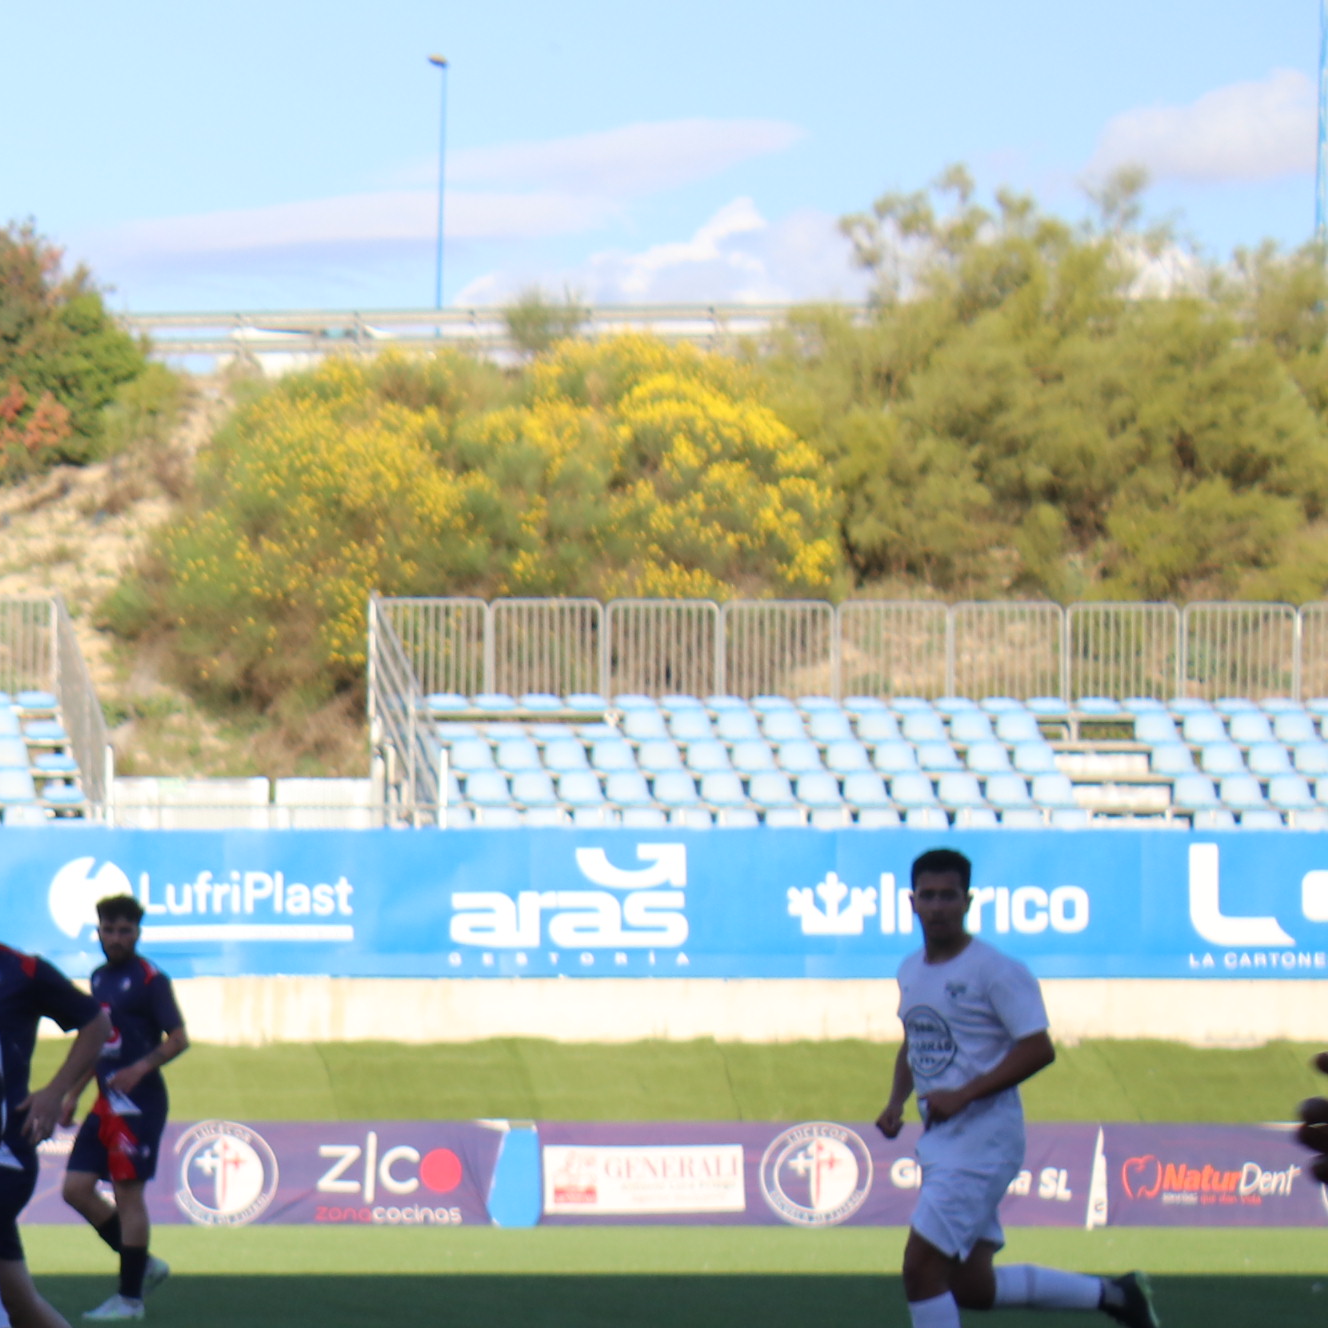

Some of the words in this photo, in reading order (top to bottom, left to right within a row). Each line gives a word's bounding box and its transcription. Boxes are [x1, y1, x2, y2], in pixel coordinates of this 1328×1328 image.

[140, 870, 354, 916] LufriPlast
[449, 889, 689, 949] aras
[1189, 952, 1216, 969] LA
[605, 1154, 738, 1180] GENERALI
[1038, 1167, 1073, 1202] SL
[1162, 1161, 1303, 1196] NaturDent
[315, 1204, 462, 1225] zonacocinas
